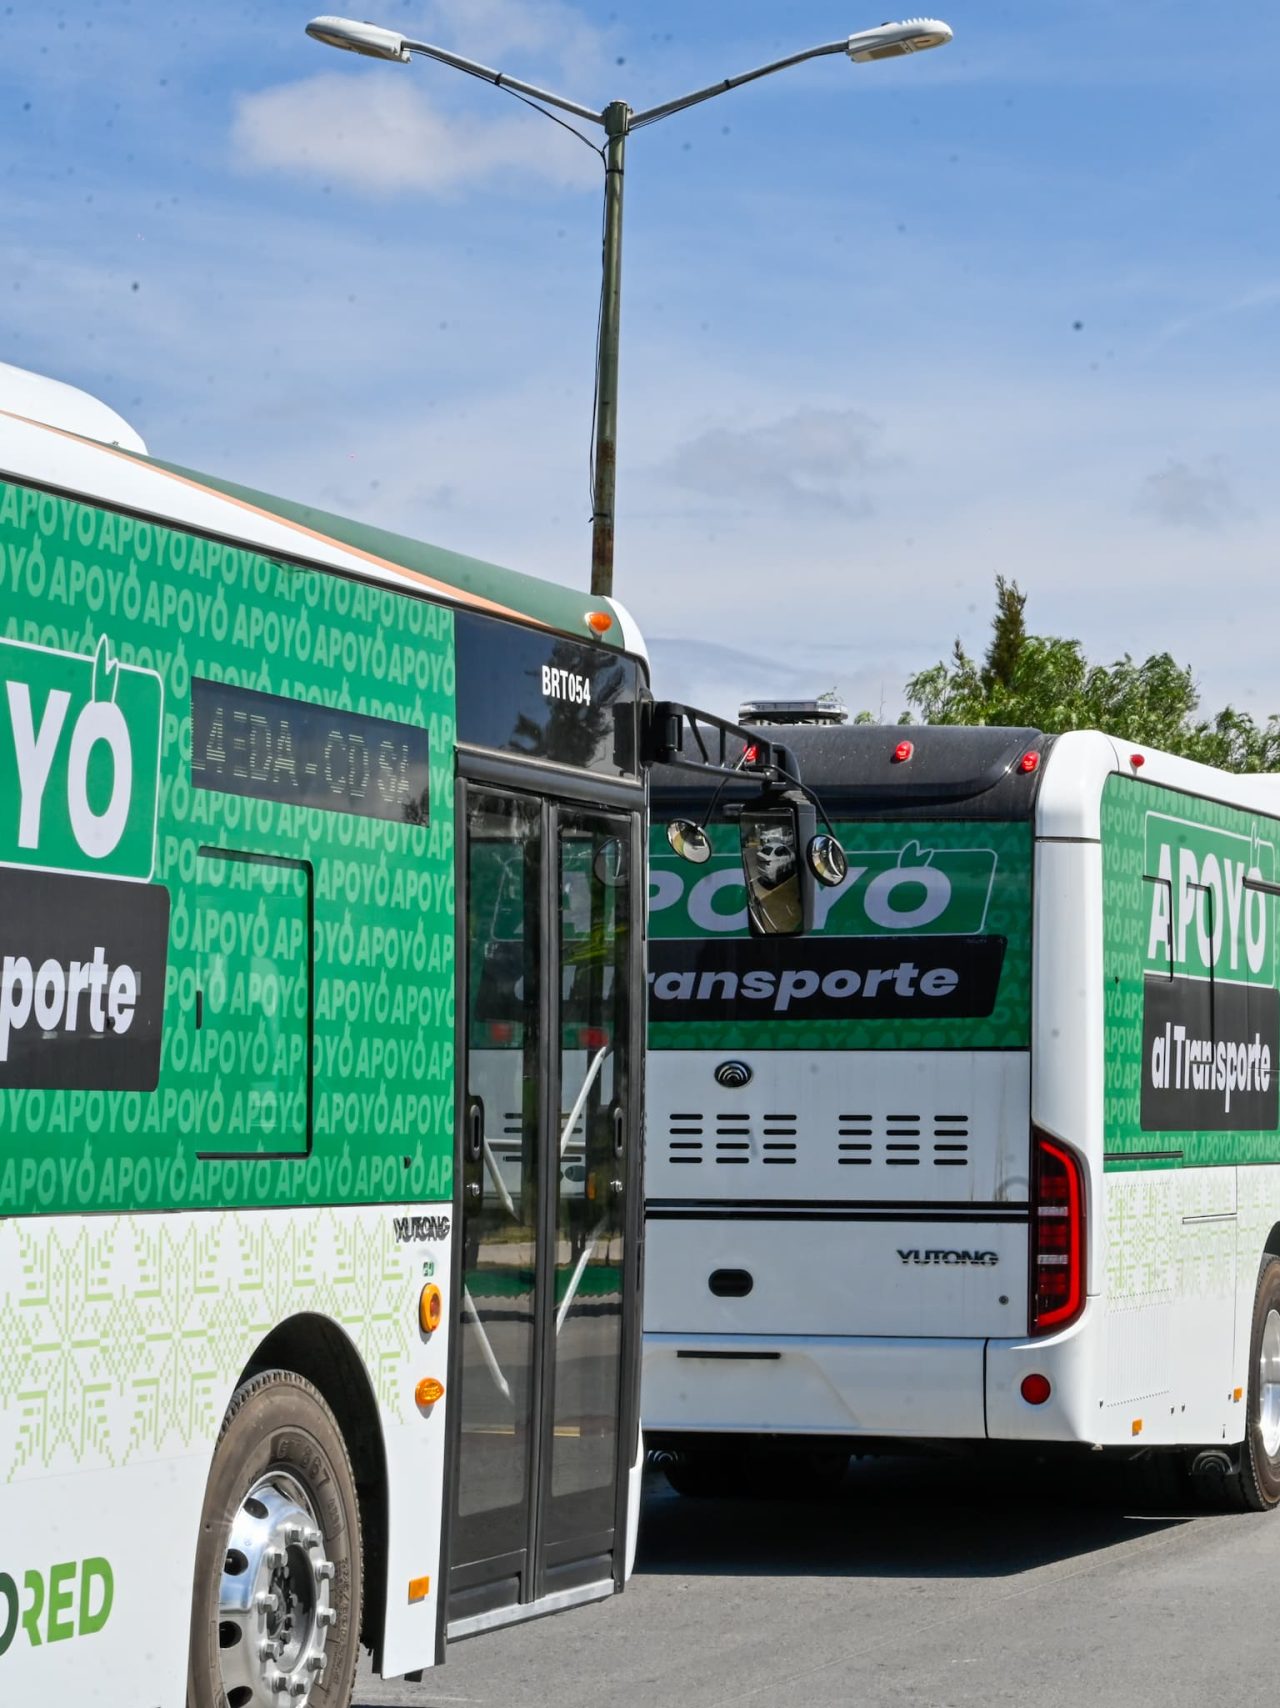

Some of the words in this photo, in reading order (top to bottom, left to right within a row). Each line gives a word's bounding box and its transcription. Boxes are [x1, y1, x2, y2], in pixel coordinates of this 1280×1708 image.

[541, 664, 591, 706] BRT054
[1148, 843, 1267, 974] APOYO
[1173, 1025, 1271, 1113] Transporte
[896, 1250, 999, 1267] YUTONG
